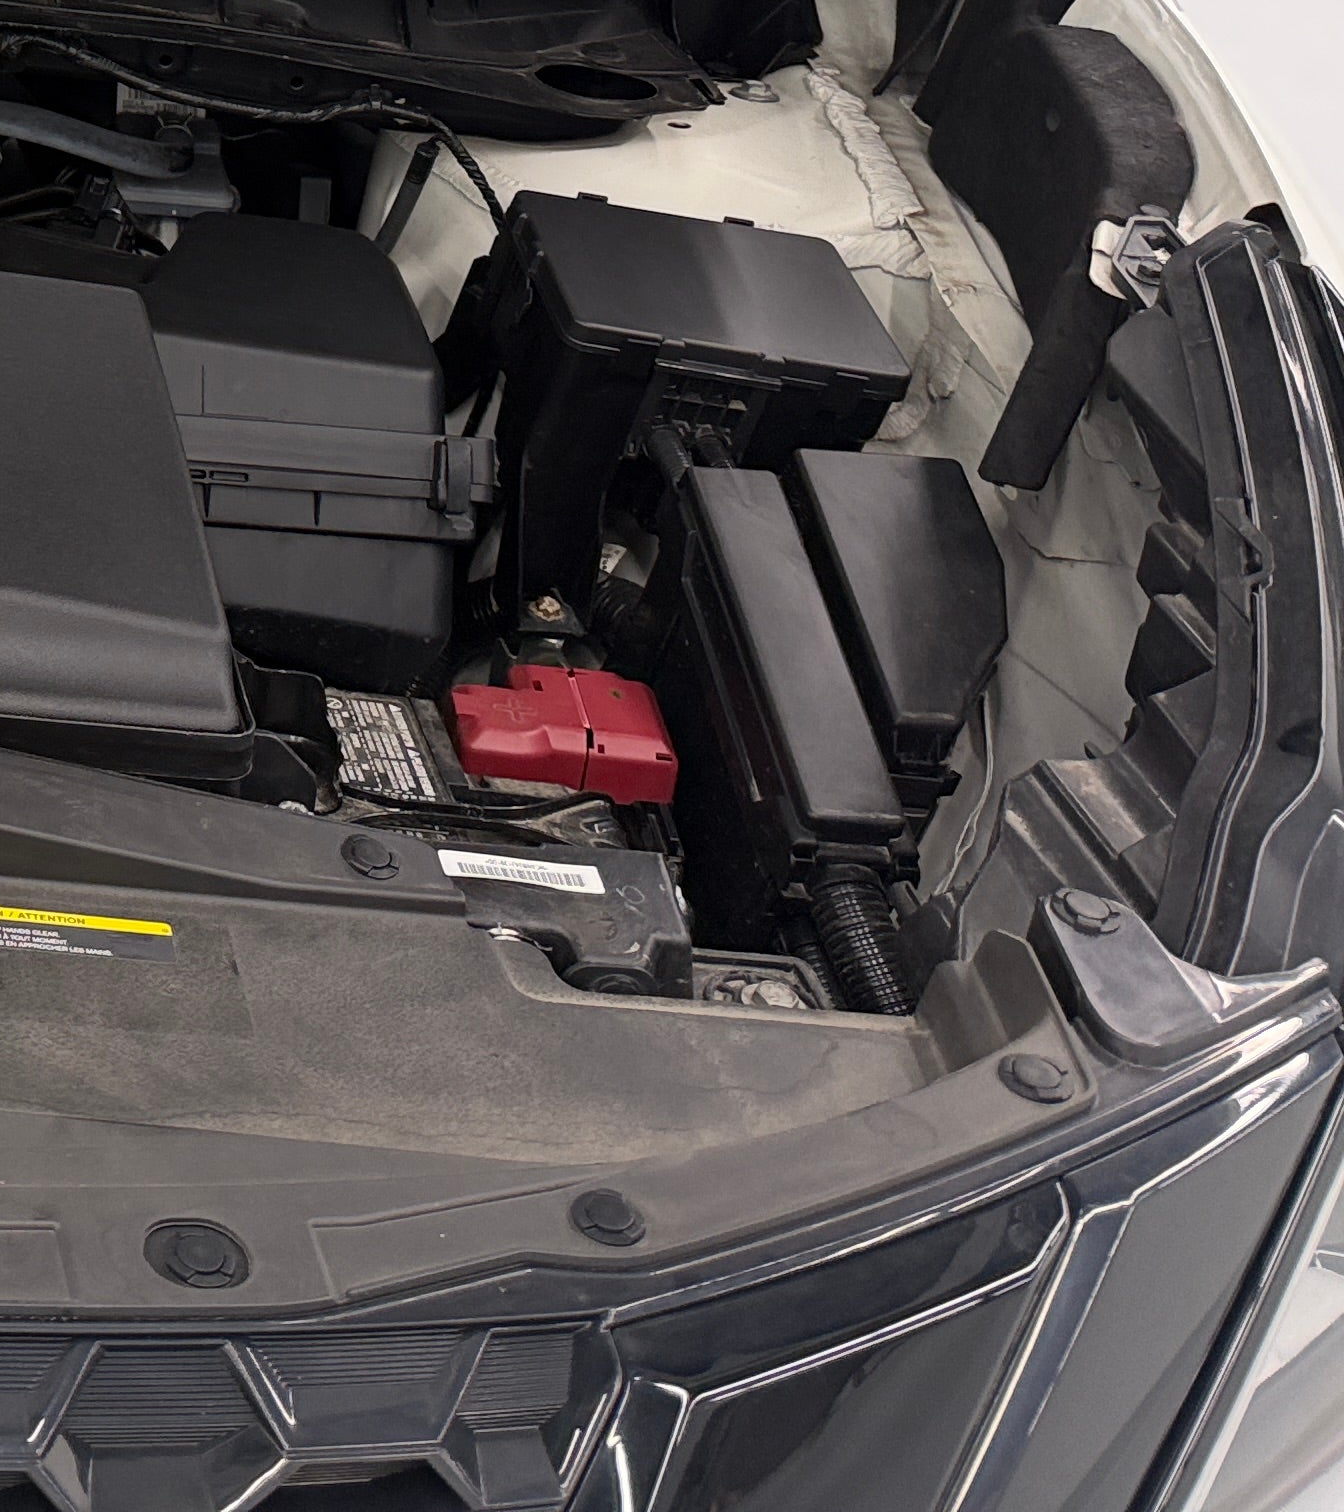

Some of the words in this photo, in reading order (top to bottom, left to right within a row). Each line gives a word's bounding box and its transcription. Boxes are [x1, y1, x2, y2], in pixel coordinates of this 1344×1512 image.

[18, 912, 86, 925] ATTENTION
[2, 927, 31, 935] HANDS
[10, 934, 31, 942] TOUT
[18, 942, 69, 952] APPROCHER
